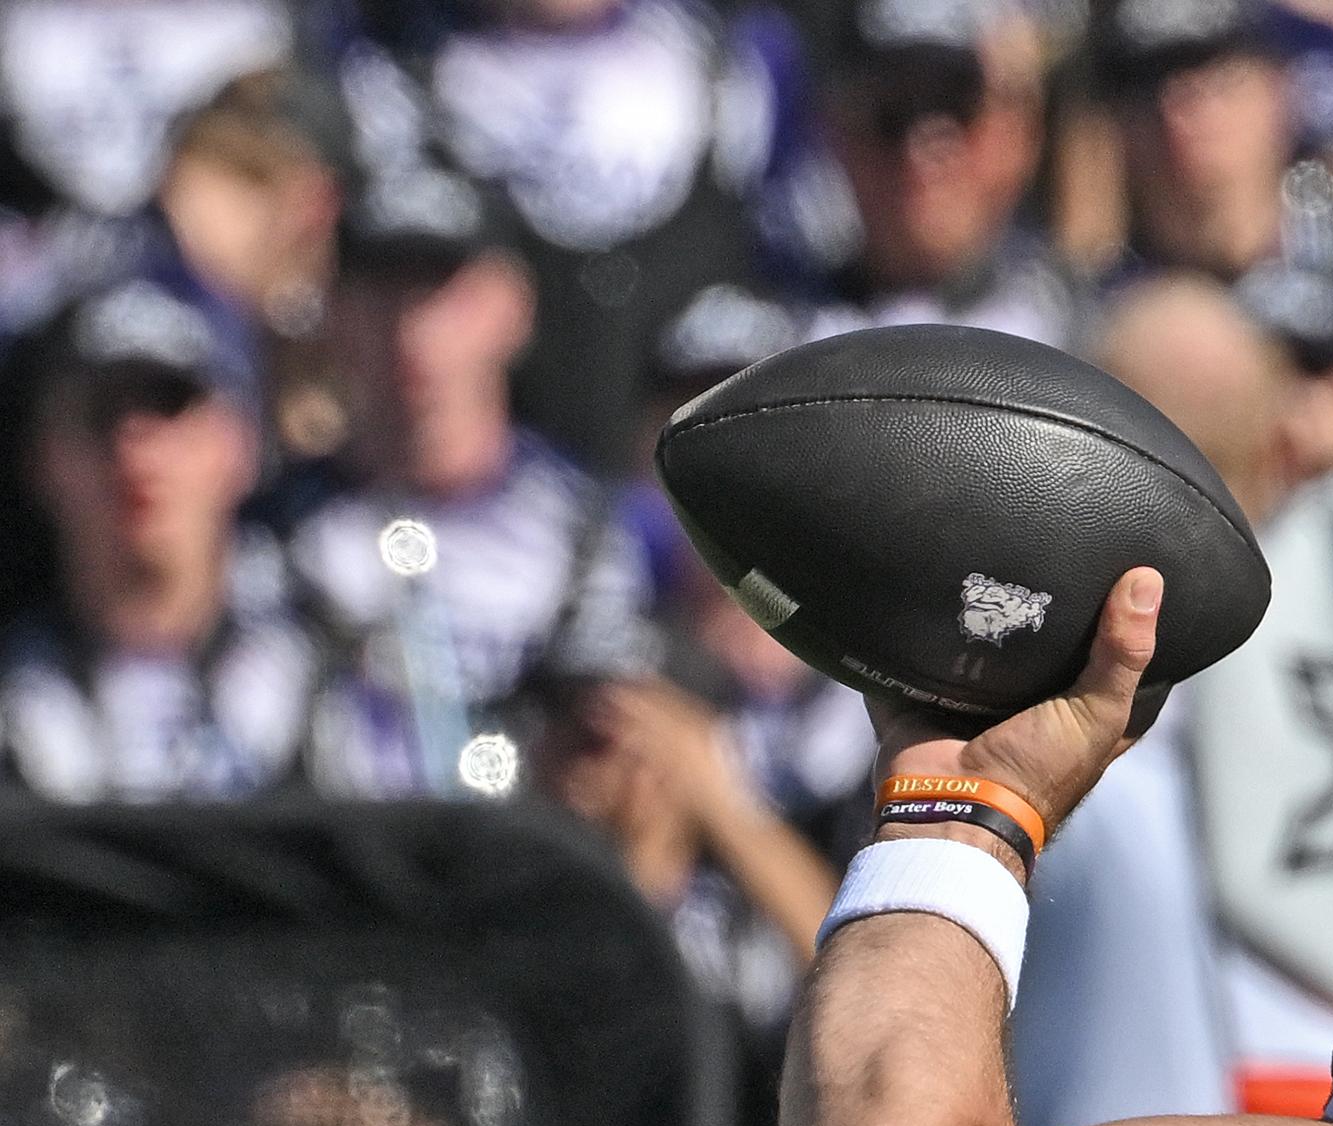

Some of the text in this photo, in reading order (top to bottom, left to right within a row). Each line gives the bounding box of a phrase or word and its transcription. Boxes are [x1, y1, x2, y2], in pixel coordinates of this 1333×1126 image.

[892, 778, 980, 794] HESTON
[880, 801, 973, 817] Carter Boys
